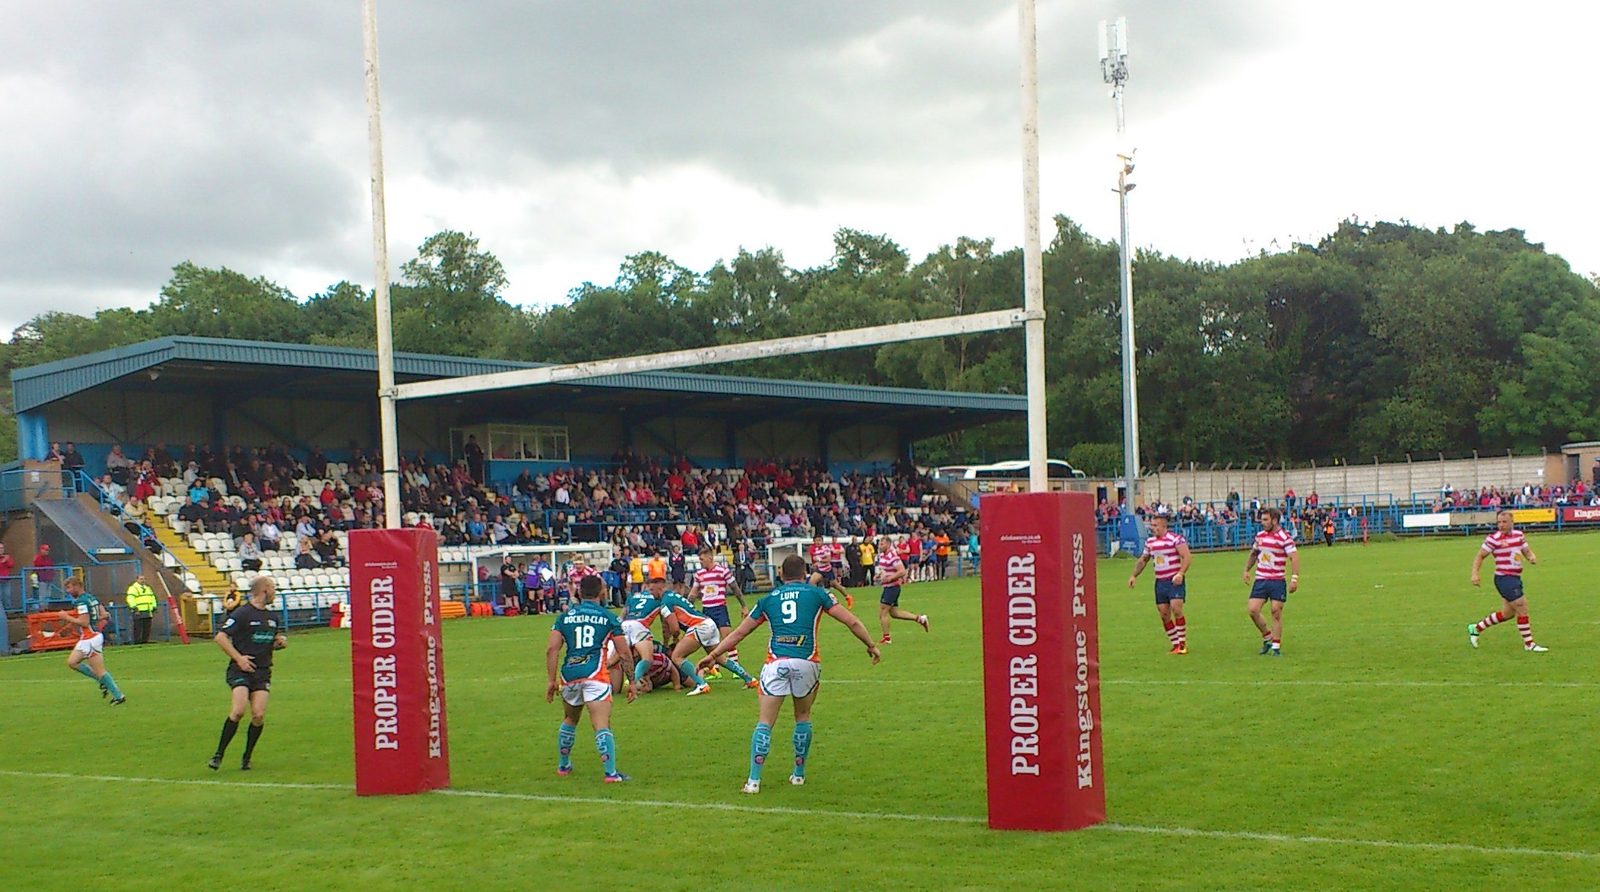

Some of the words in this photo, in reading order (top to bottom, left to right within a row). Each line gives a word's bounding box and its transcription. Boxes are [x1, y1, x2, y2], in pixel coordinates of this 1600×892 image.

[370, 575, 397, 649] CIDER
[422, 560, 436, 626] Press
[635, 598, 647, 609] 2
[780, 591, 800, 600] LUNT
[781, 600, 797, 624] 9
[1007, 552, 1038, 646] CIDER
[1071, 532, 1087, 618] Press
[576, 624, 598, 649] 18
[373, 654, 399, 751] PROPER
[426, 635, 442, 759] Kingstone
[1010, 654, 1040, 776] PROPER
[1075, 629, 1094, 790] Kingstone
